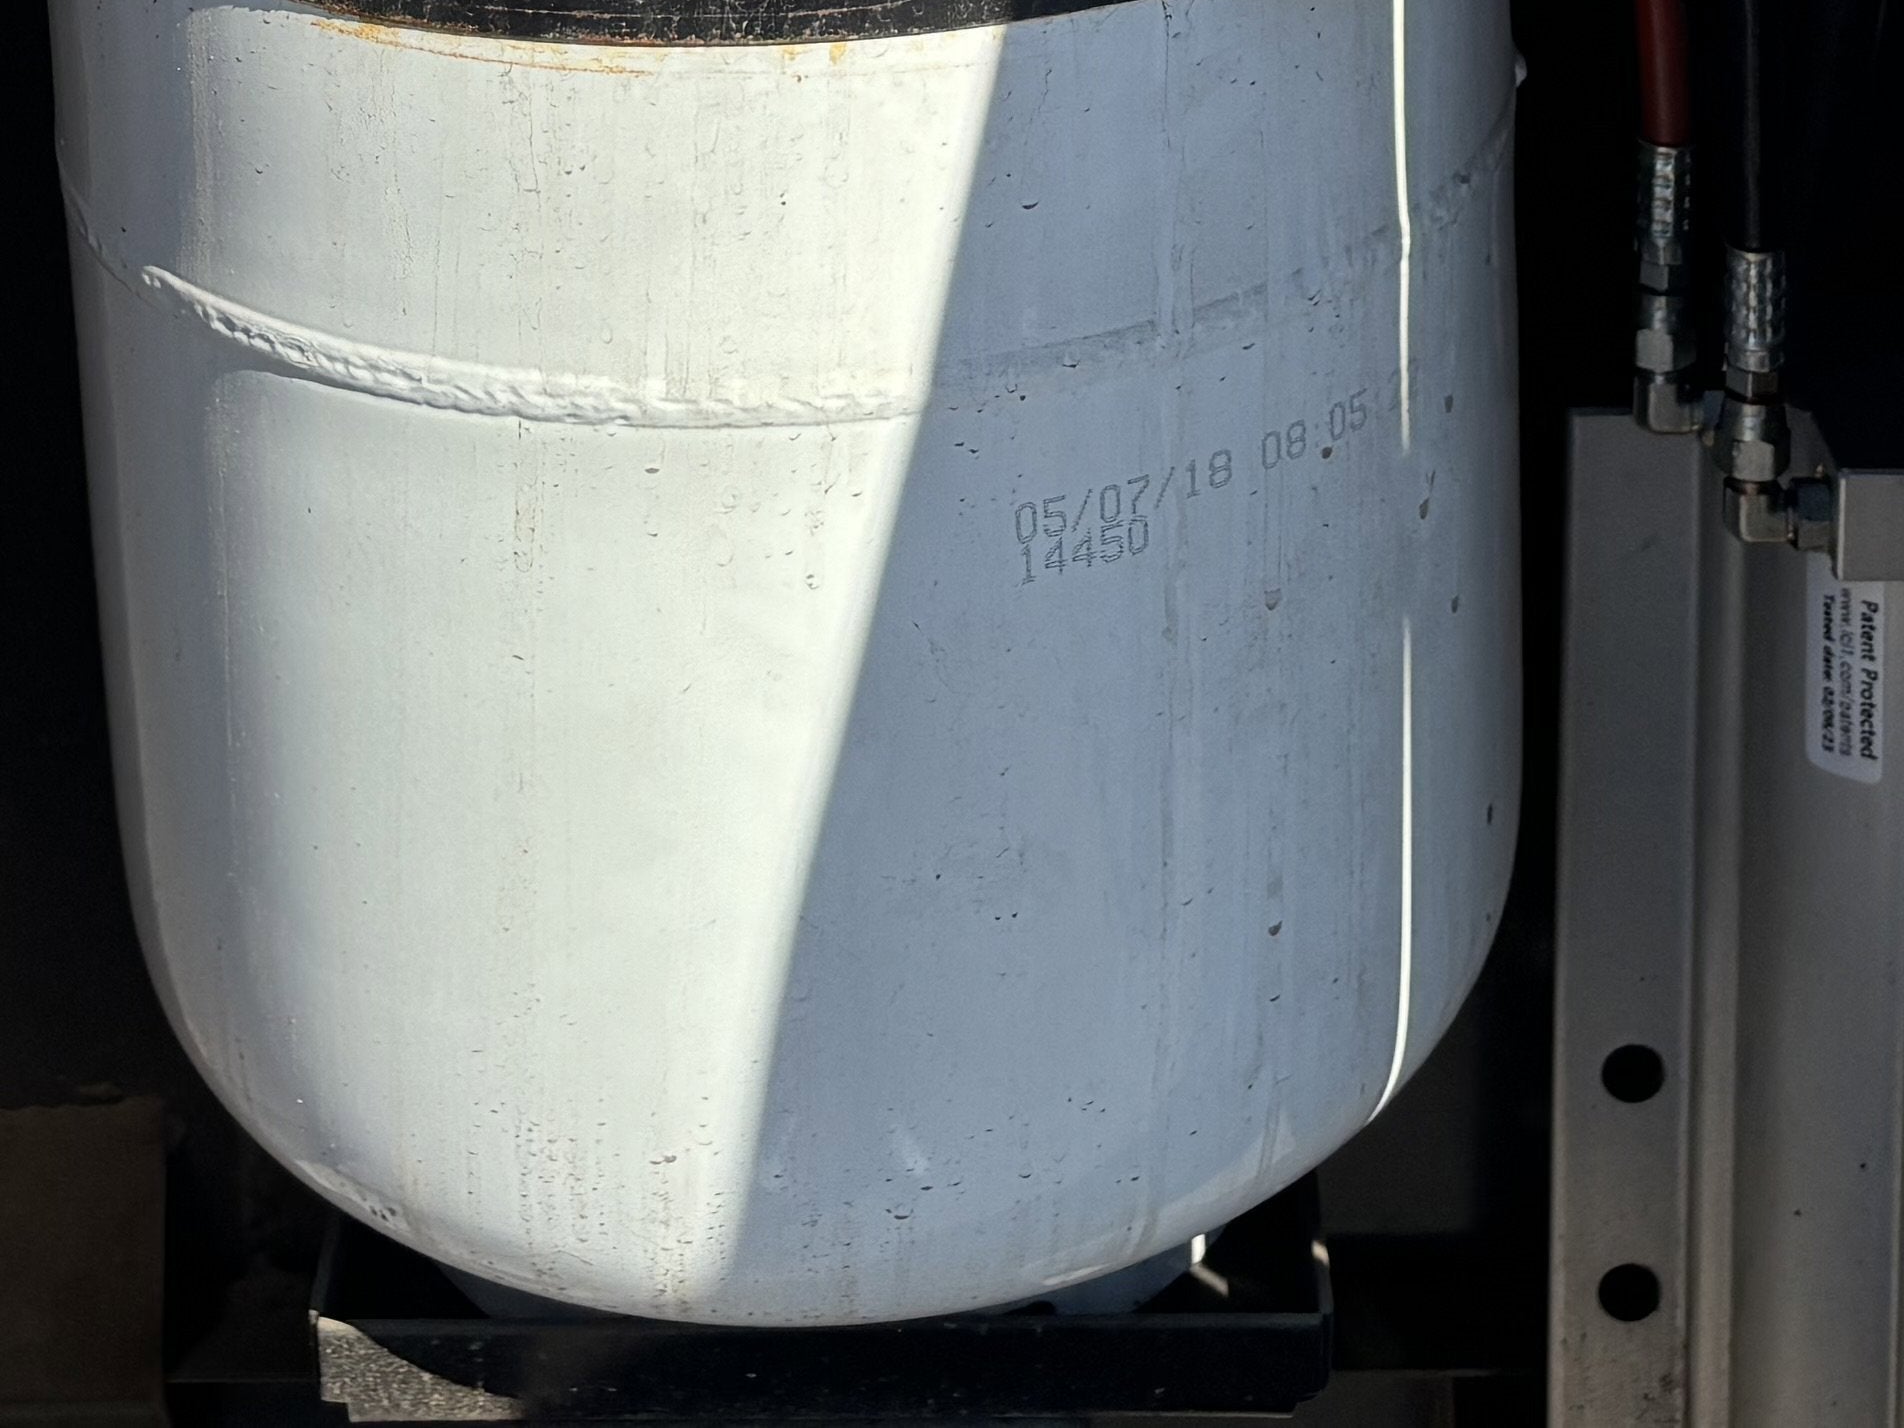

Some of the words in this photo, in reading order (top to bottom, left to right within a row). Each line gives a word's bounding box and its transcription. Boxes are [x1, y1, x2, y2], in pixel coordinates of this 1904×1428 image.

[1014, 448, 1233, 544] 05/07/18
[1017, 514, 1150, 586] 14450
[1860, 599, 1879, 662] Patent
[1860, 668, 1879, 761] Protected
